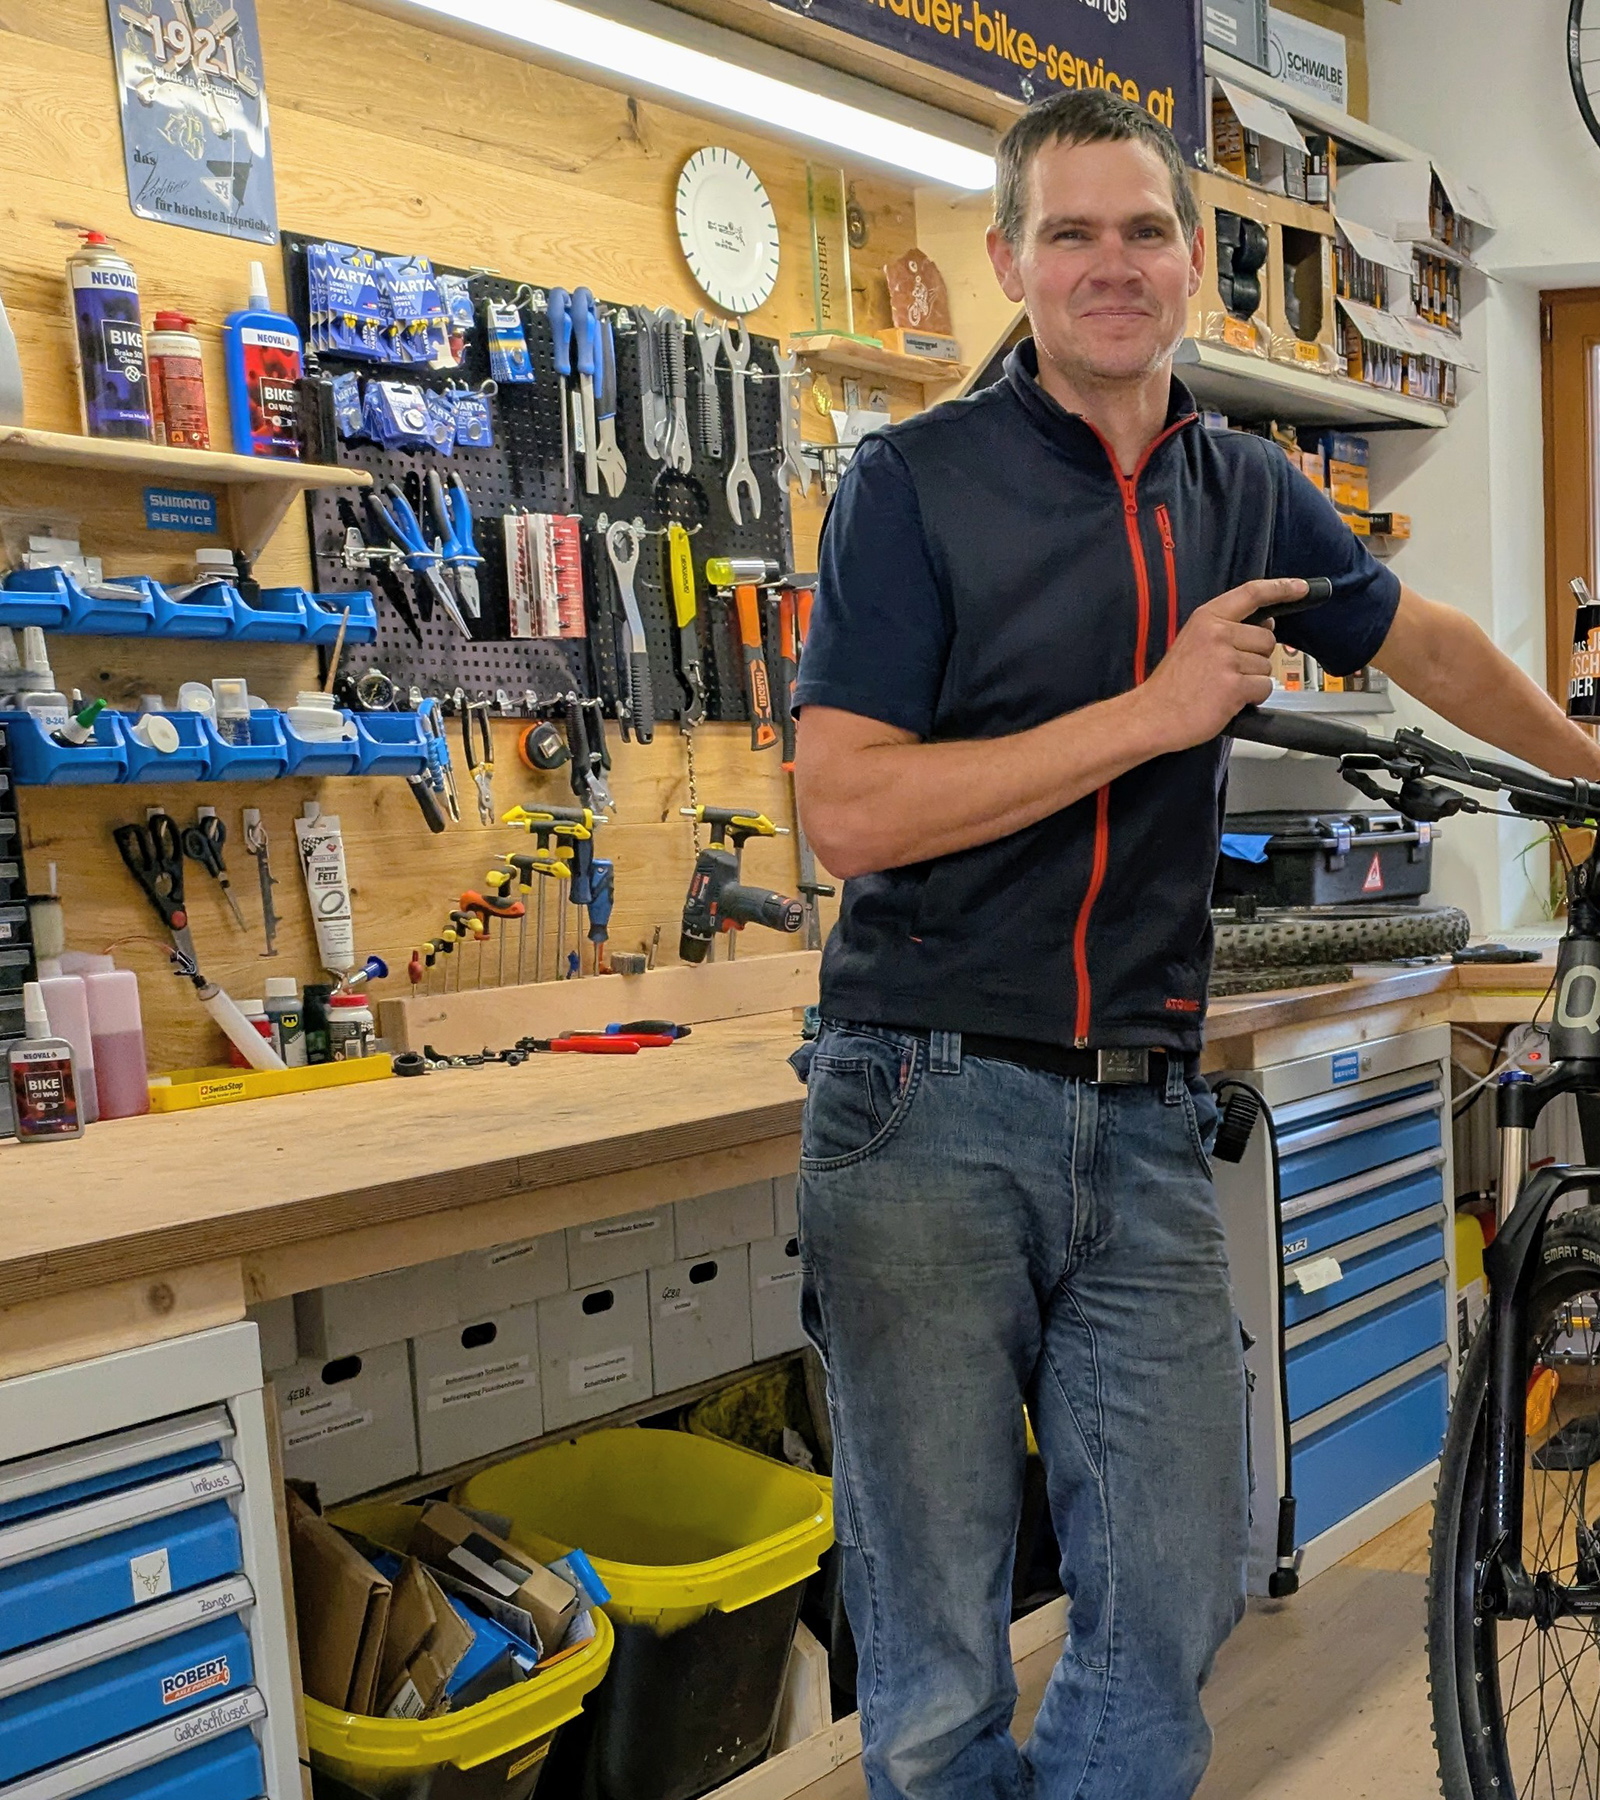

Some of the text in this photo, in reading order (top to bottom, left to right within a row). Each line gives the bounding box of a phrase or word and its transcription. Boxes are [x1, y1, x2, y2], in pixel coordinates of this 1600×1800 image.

[148, 15, 238, 78] 1921
[155, 66, 184, 85] Made
[185, 76, 197, 88] in
[1287, 51, 1343, 86] SCHWALBE
[155, 197, 172, 213] für
[174, 202, 219, 222] höchste
[91, 271, 136, 290] NEOVAL
[329, 265, 376, 288] VARTA
[820, 234, 832, 320] FINISHER
[389, 279, 436, 294] VARTA
[110, 329, 142, 348] BIKE
[257, 333, 285, 346] NEOVAL
[264, 387, 294, 403] BIKE
[427, 400, 456, 426] VARTA
[453, 400, 486, 412] VARTA
[149, 494, 211, 511] SHIMANO
[151, 512, 212, 526] SERVICE
[755, 671, 767, 707] HARDEN
[317, 872, 338, 881] FETT
[23, 1052, 51, 1060] NEOVAL
[28, 1078, 61, 1091] BIKE
[208, 1081, 244, 1095] SwissStop
[42, 1090, 59, 1098] W40
[1284, 1239, 1306, 1254] XTR
[1543, 1246, 1578, 1265] SMART
[163, 1657, 227, 1694] ROBERT
